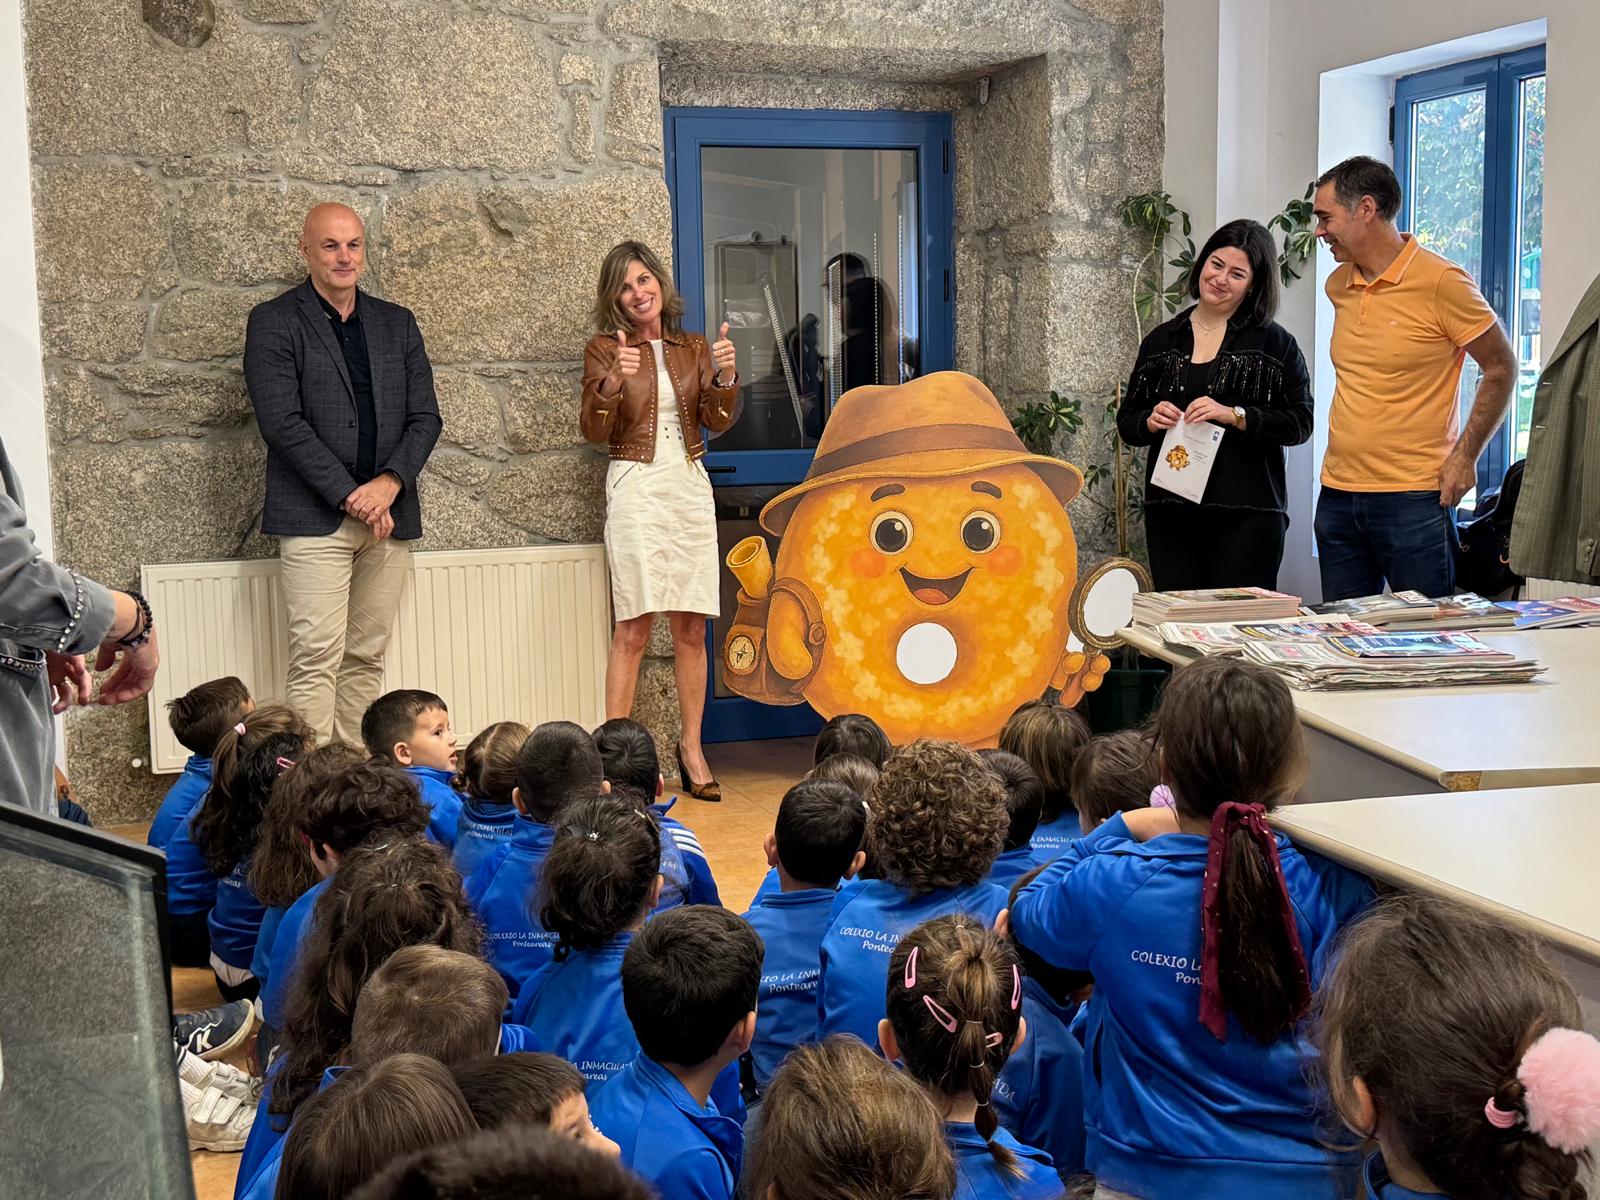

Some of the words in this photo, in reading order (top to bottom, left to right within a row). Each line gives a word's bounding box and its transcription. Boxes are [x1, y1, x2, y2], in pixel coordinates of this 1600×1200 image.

[875, 931, 887, 941] LA
[862, 940, 896, 954] Pontea
[1131, 950, 1188, 969] COLEXIO
[769, 980, 818, 994] Ponteare
[580, 1060, 625, 1072] INMACULA
[584, 1072, 608, 1081] areas
